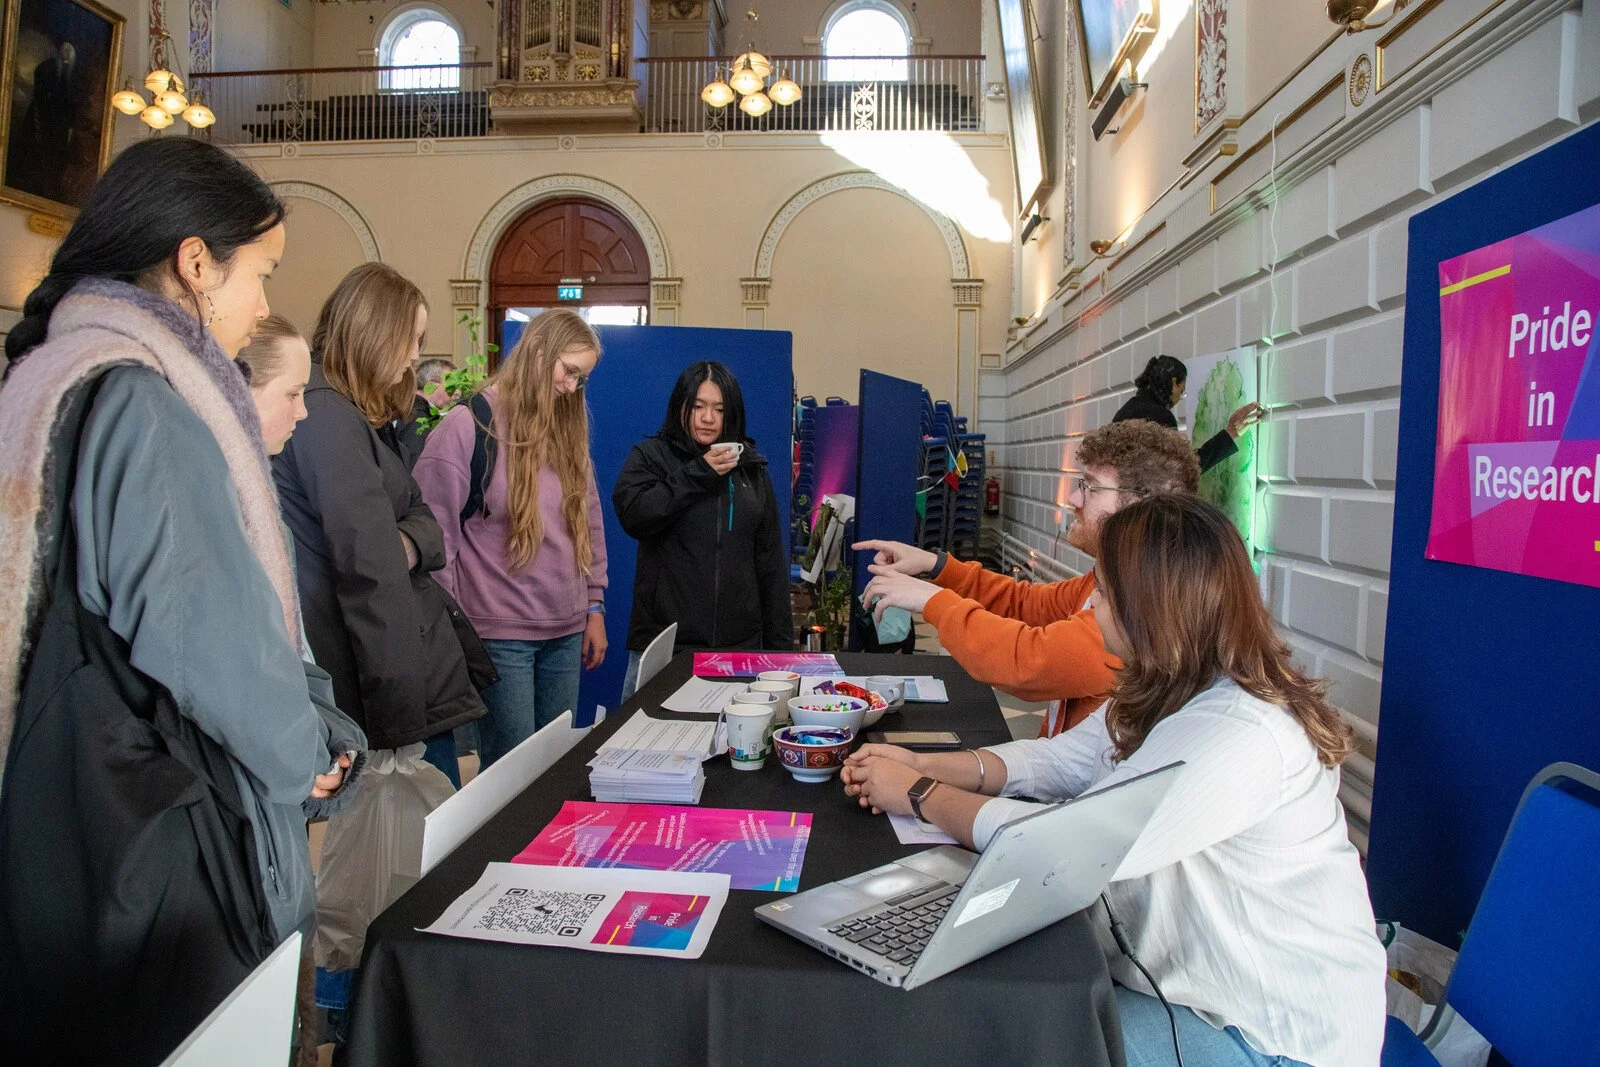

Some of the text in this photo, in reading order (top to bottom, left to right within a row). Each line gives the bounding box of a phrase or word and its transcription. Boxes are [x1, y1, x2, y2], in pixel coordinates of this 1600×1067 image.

[1509, 301, 1591, 358] Pride
[1528, 382, 1555, 427] in
[624, 905, 647, 929] Research
[663, 912, 681, 927] Pride
